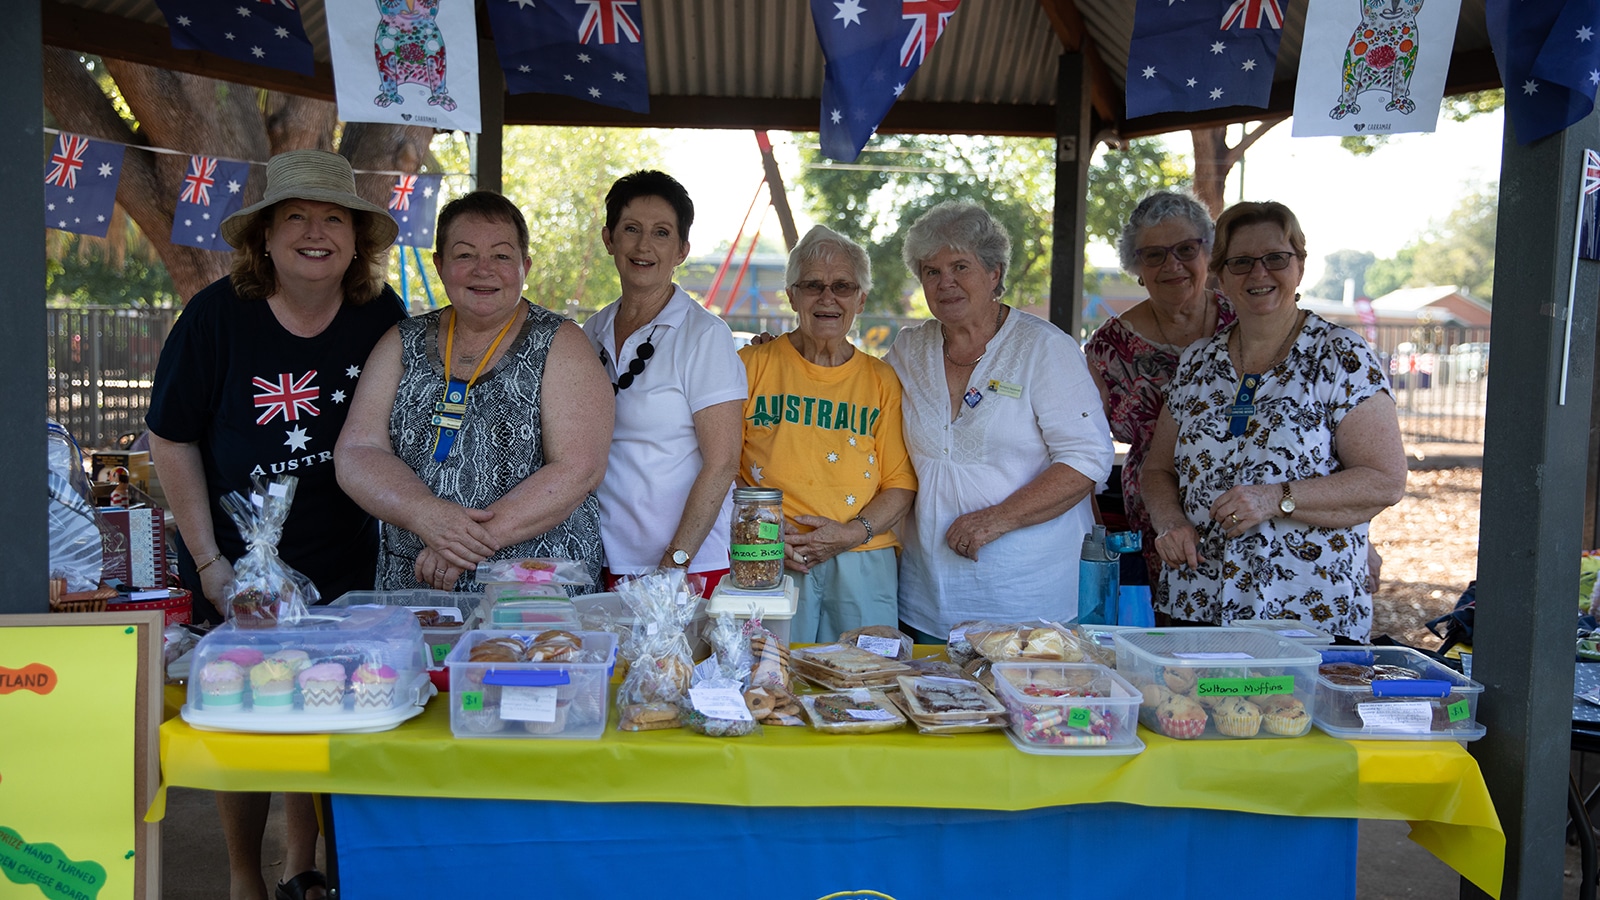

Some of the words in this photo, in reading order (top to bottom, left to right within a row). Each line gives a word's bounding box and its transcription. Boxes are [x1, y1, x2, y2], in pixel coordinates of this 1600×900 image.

[754, 394, 881, 437] AUSTRALIA
[250, 450, 334, 476] AUSTR
[114, 531, 127, 553] 2
[465, 694, 478, 706] $1
[1199, 683, 1239, 694] Sultana
[1244, 682, 1284, 695] Muffins
[17, 864, 55, 887] CHEESE
[23, 844, 53, 864] HAND
[57, 859, 97, 885] TURNED
